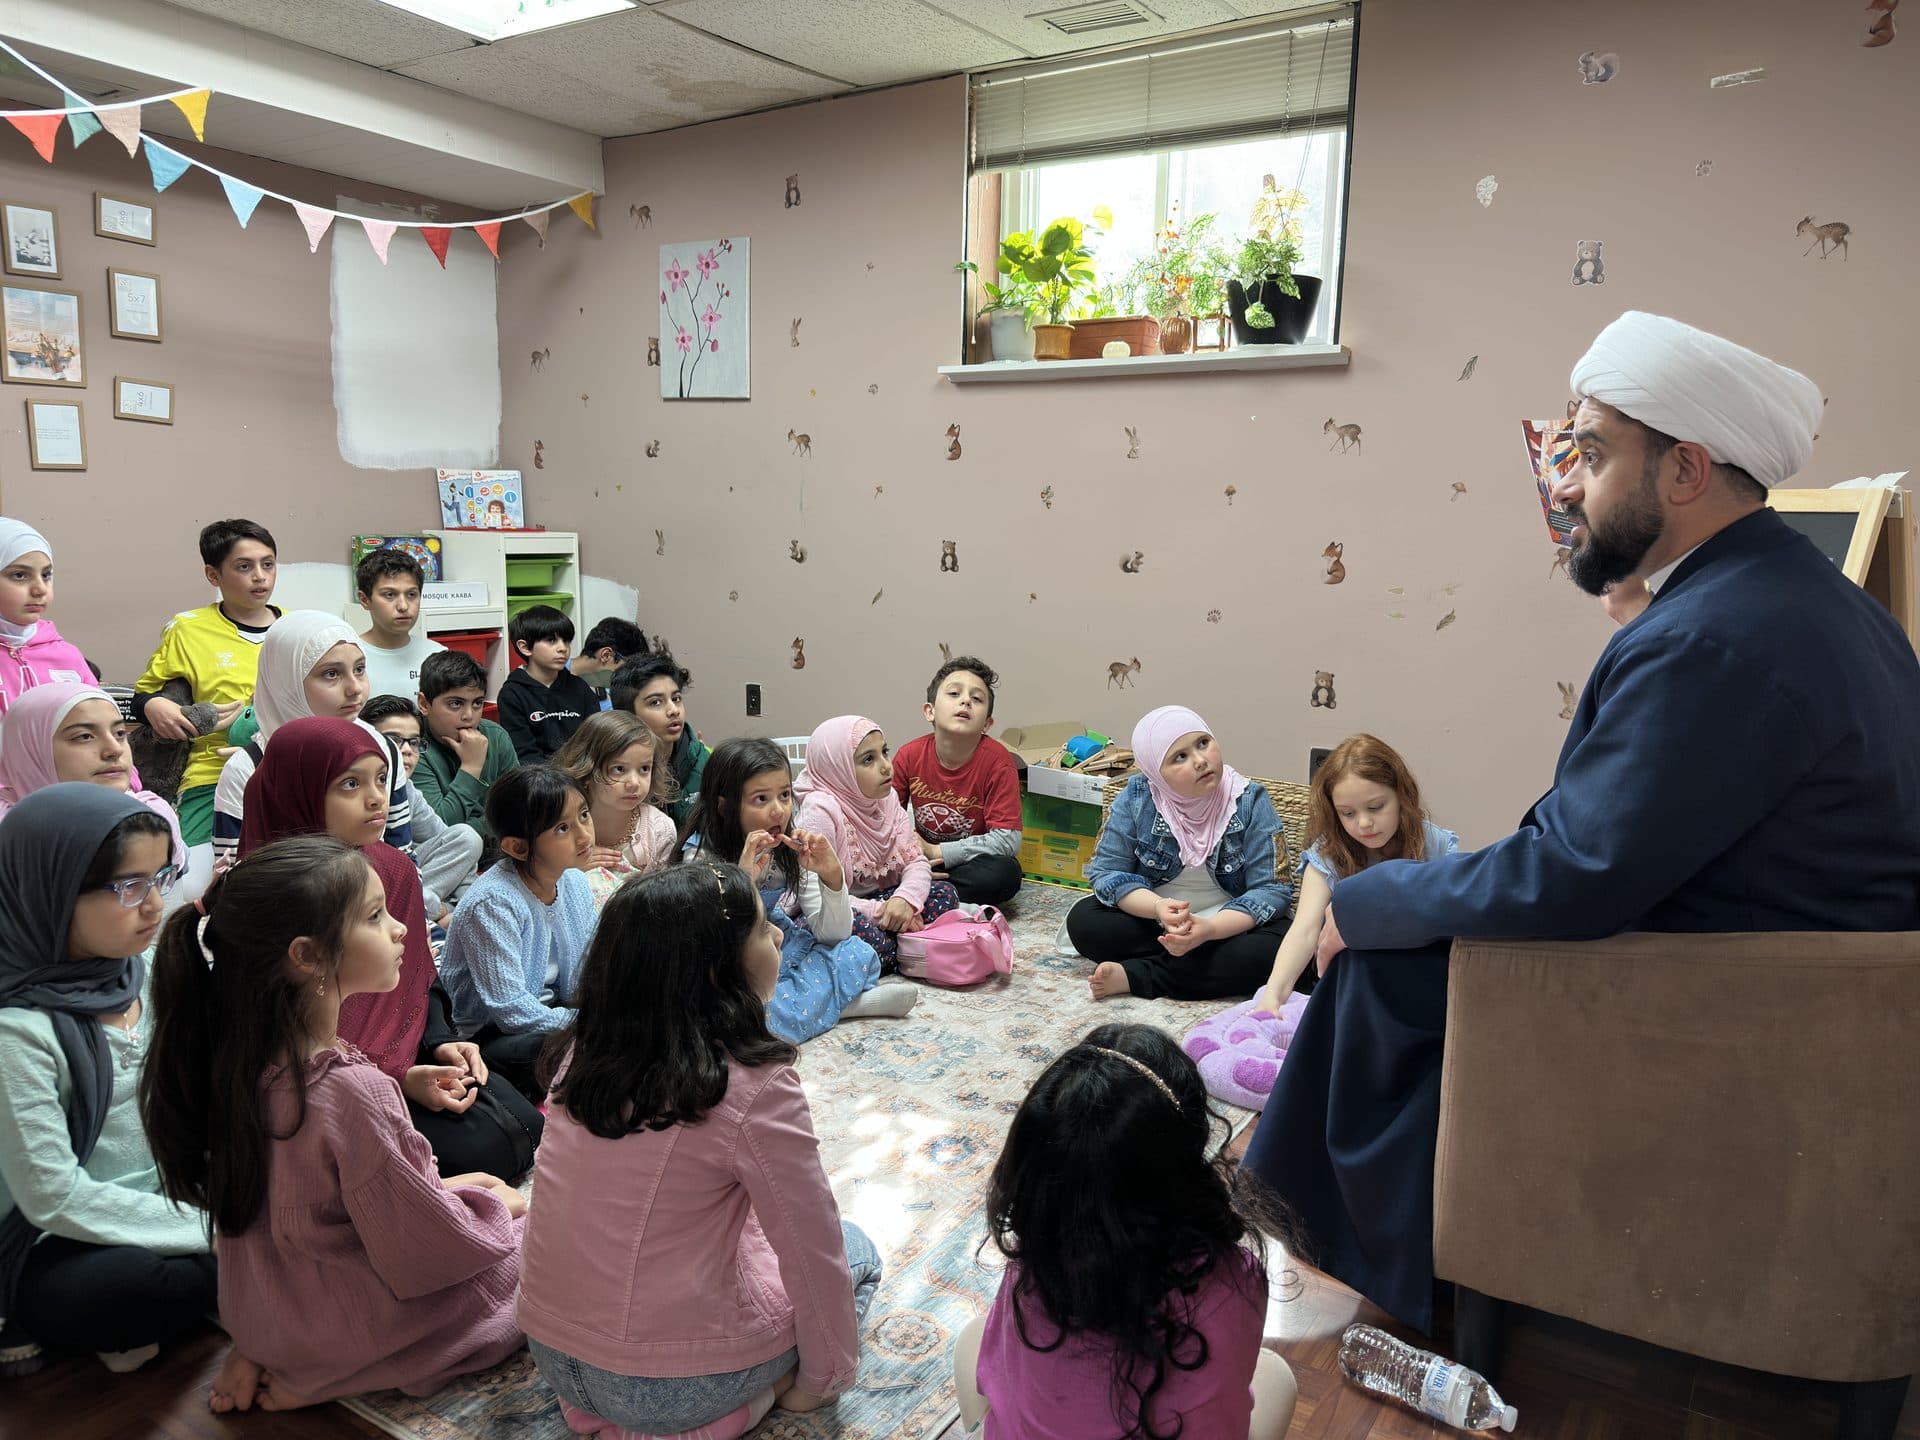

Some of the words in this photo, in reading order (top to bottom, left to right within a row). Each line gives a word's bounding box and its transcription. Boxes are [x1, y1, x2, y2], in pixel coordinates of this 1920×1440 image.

[127, 292, 146, 304] 5x7
[422, 592, 449, 600] MOSQUE
[529, 709, 581, 722] Champion
[909, 776, 984, 814] Mustang
